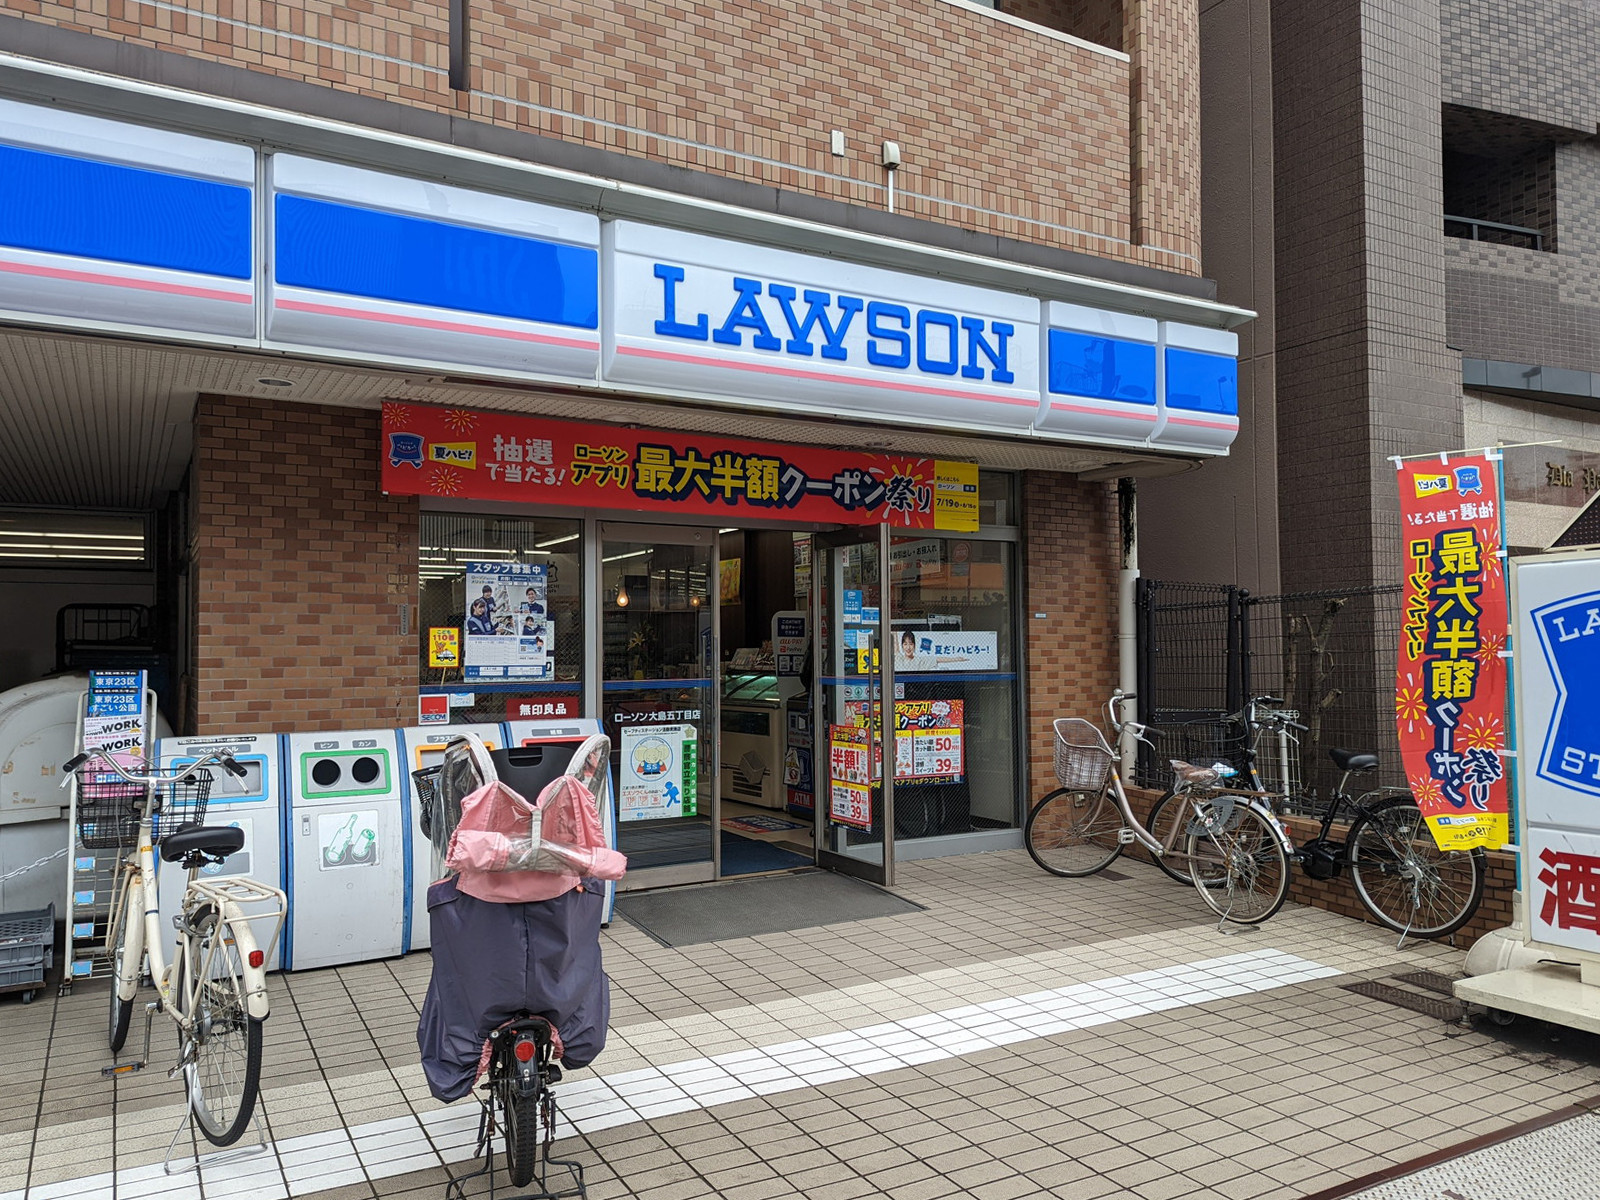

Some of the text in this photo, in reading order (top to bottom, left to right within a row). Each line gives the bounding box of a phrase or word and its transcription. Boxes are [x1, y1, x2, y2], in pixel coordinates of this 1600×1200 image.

[654, 263, 1014, 384] LAWSON
[493, 434, 553, 466] 抽選
[574, 444, 628, 462] ローソン
[485, 463, 567, 487] で当たる!
[570, 462, 630, 489] アプリ
[1552, 608, 1600, 642] LA
[95, 677, 136, 686] 東京23区
[94, 695, 135, 704] 東京23区
[519, 703, 567, 716] 無印良品
[614, 710, 701, 722] ローソン大島五丁目店
[101, 719, 142, 733] WORK
[101, 737, 142, 752] WORK
[199, 746, 239, 754] ペットル
[935, 737, 952, 752] 50
[832, 748, 860, 770] 半額!
[935, 758, 952, 773] 39
[793, 792, 810, 806] ATM
[850, 789, 861, 804] 50
[850, 804, 861, 819] 39
[1537, 847, 1600, 936] 酒
